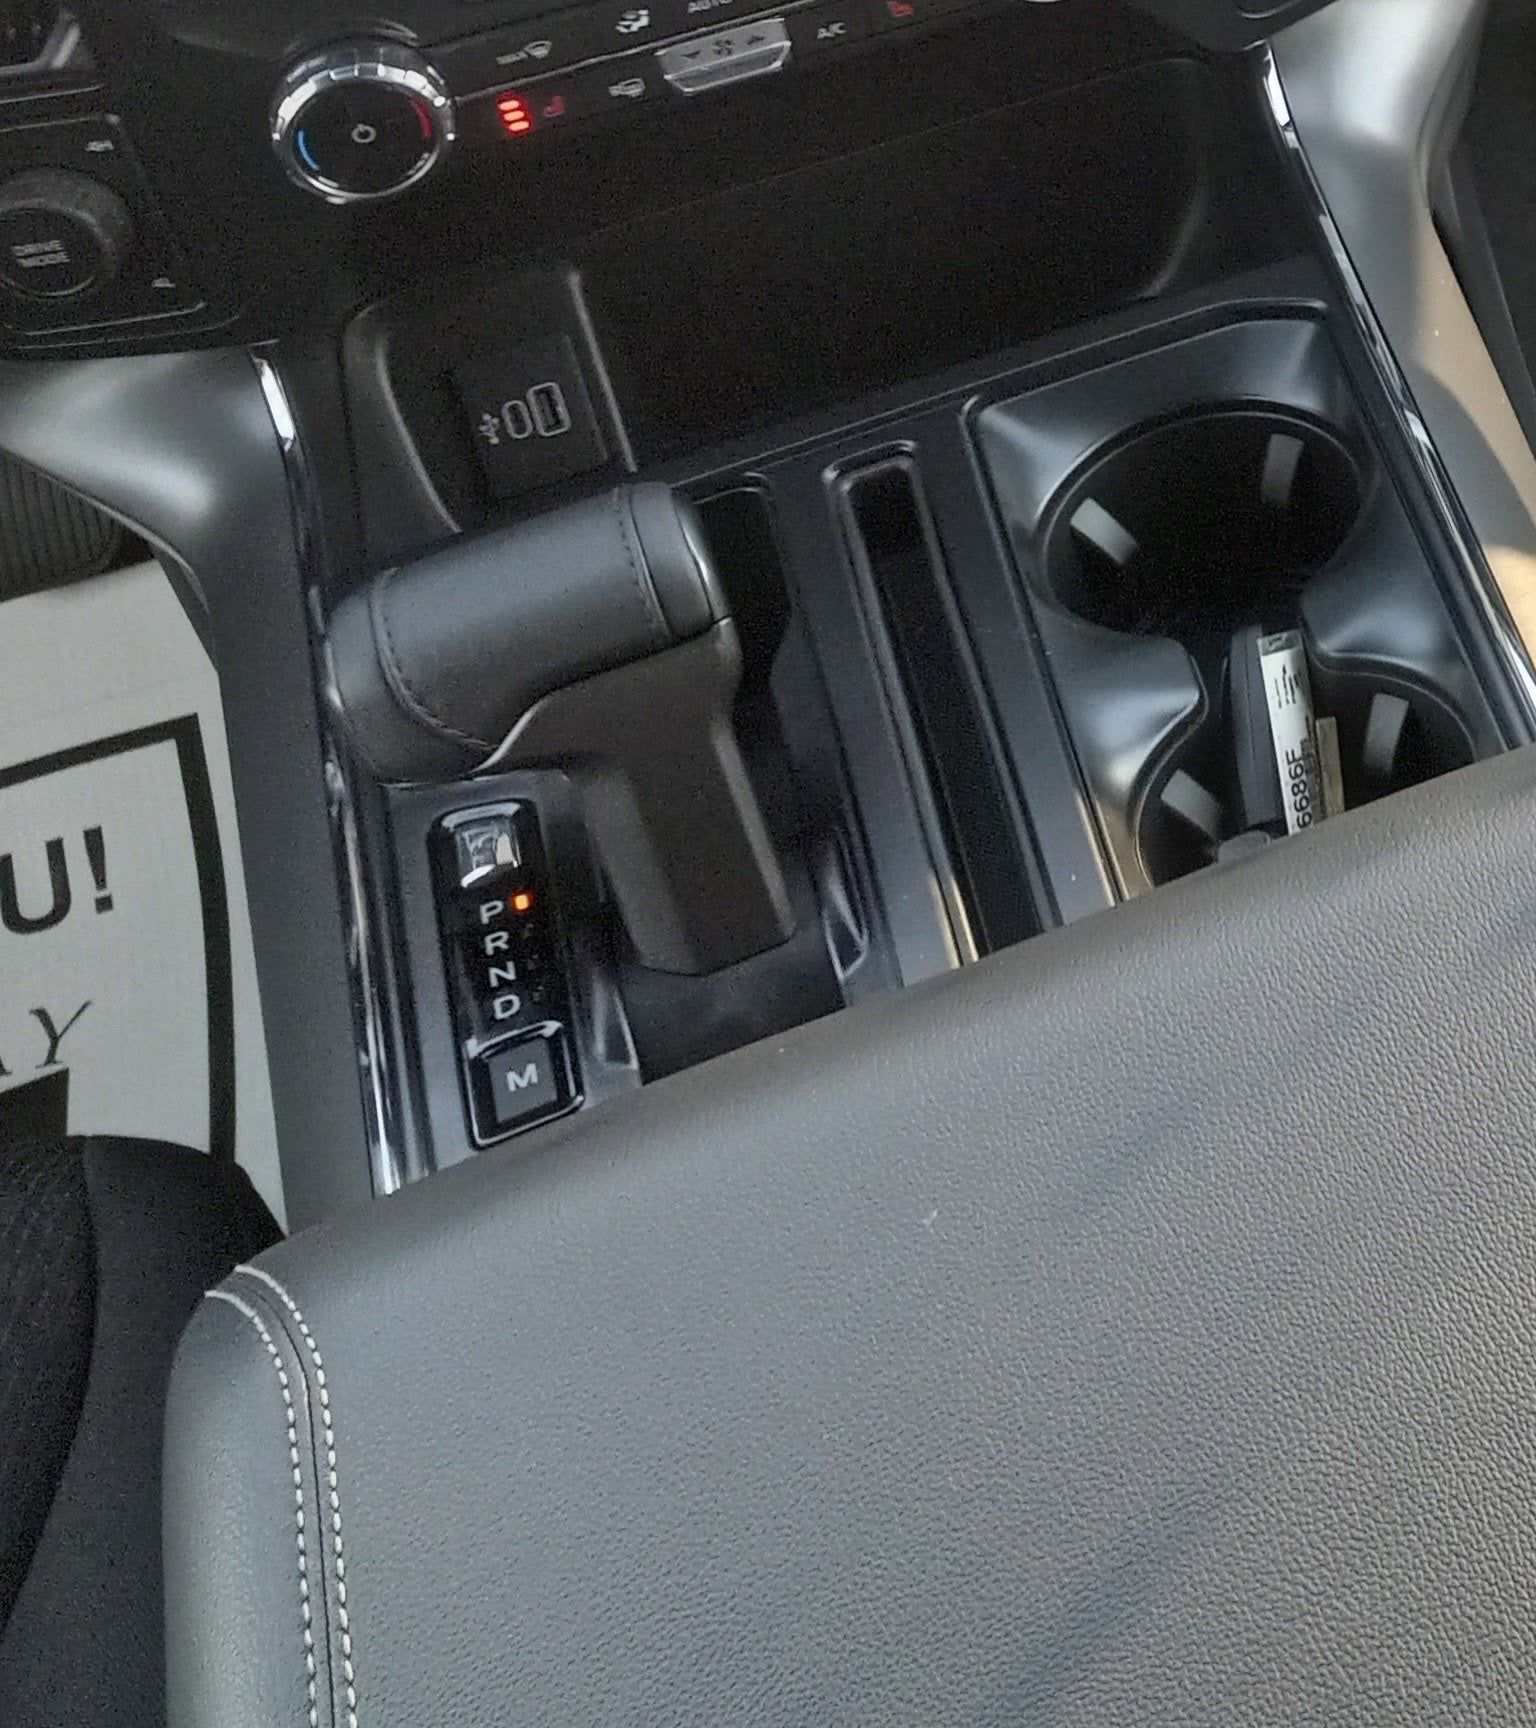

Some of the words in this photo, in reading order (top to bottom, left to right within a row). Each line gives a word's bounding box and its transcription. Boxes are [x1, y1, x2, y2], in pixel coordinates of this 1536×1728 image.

[816, 21, 847, 40] A/C
[480, 900, 503, 924] P
[485, 931, 509, 956] R
[489, 960, 517, 987] N
[493, 993, 521, 1020] D
[506, 1063, 538, 1092] M
